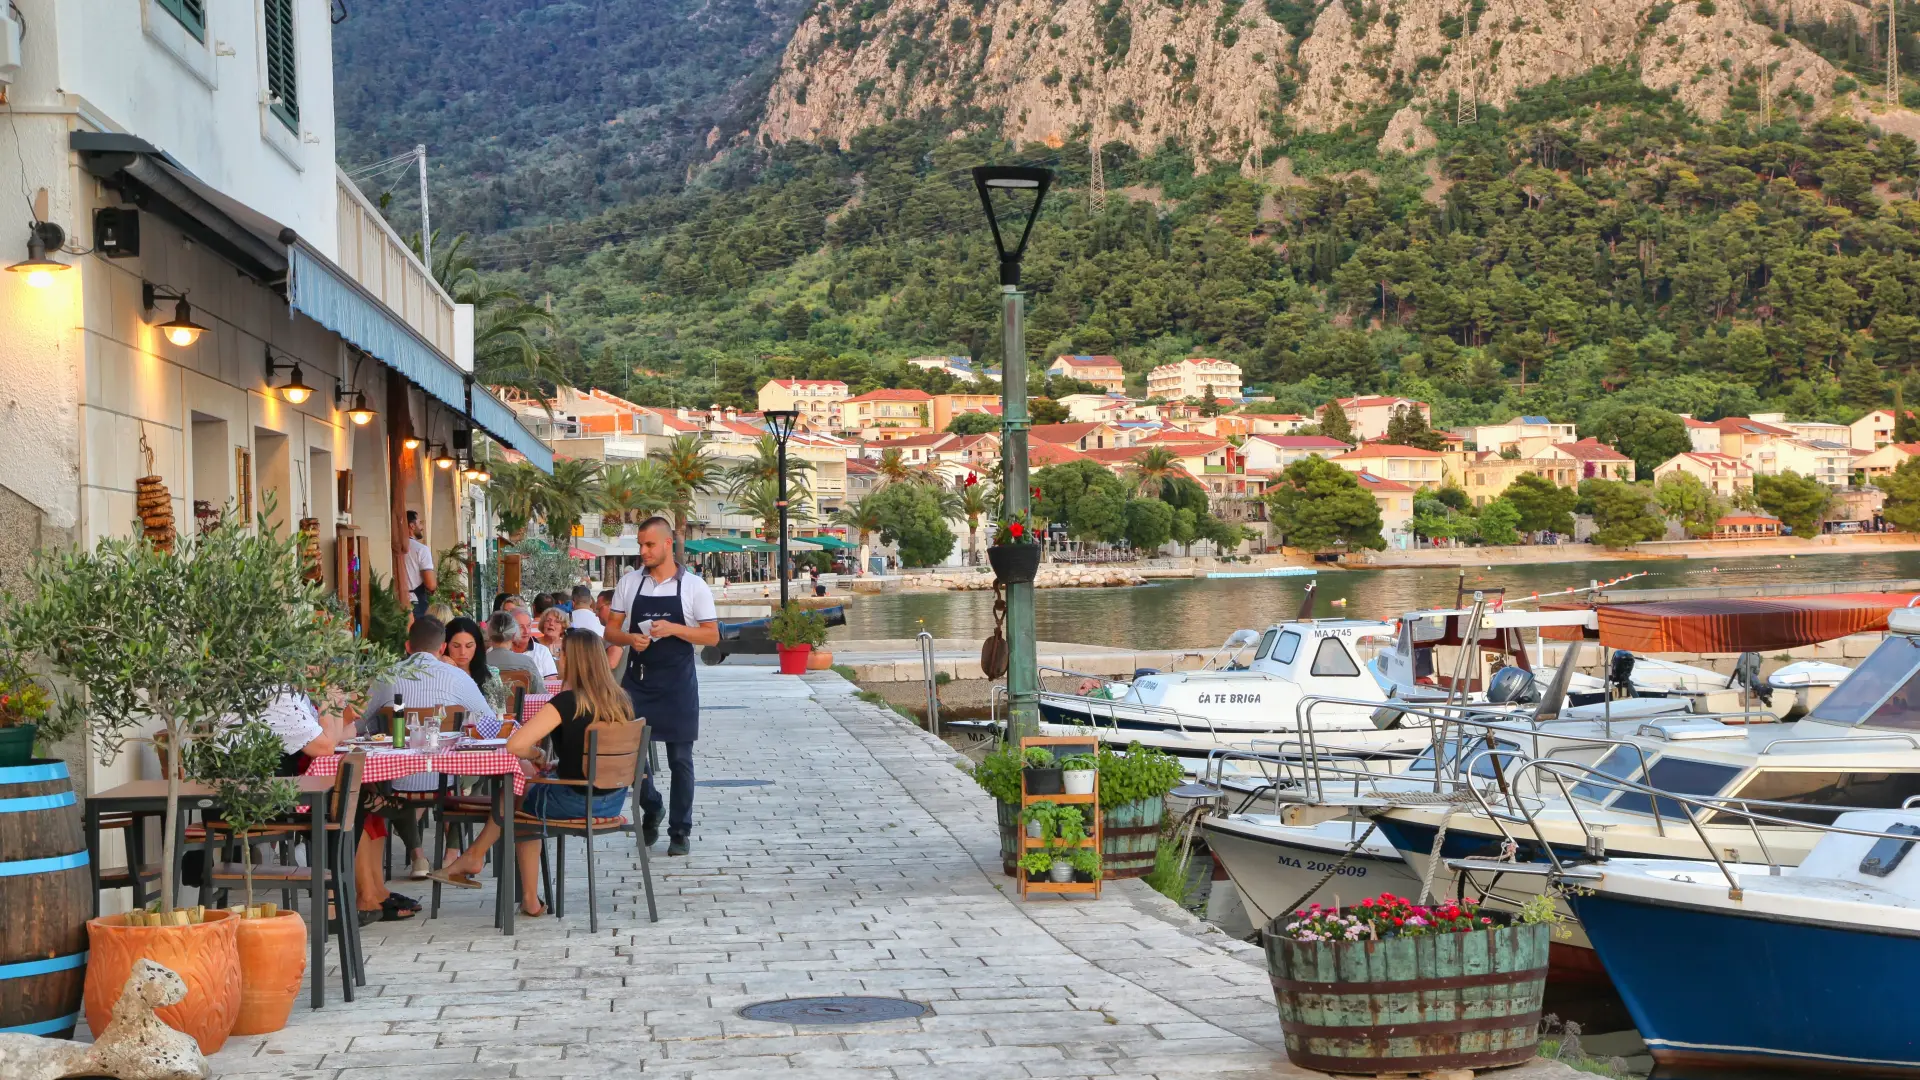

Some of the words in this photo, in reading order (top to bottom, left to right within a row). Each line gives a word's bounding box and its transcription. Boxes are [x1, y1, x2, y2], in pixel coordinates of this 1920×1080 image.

[1314, 630, 1328, 638] MA
[1331, 628, 1352, 637] 2745
[1214, 694, 1227, 704] TE
[1229, 693, 1261, 704] BRIGA
[1277, 855, 1302, 869] MA
